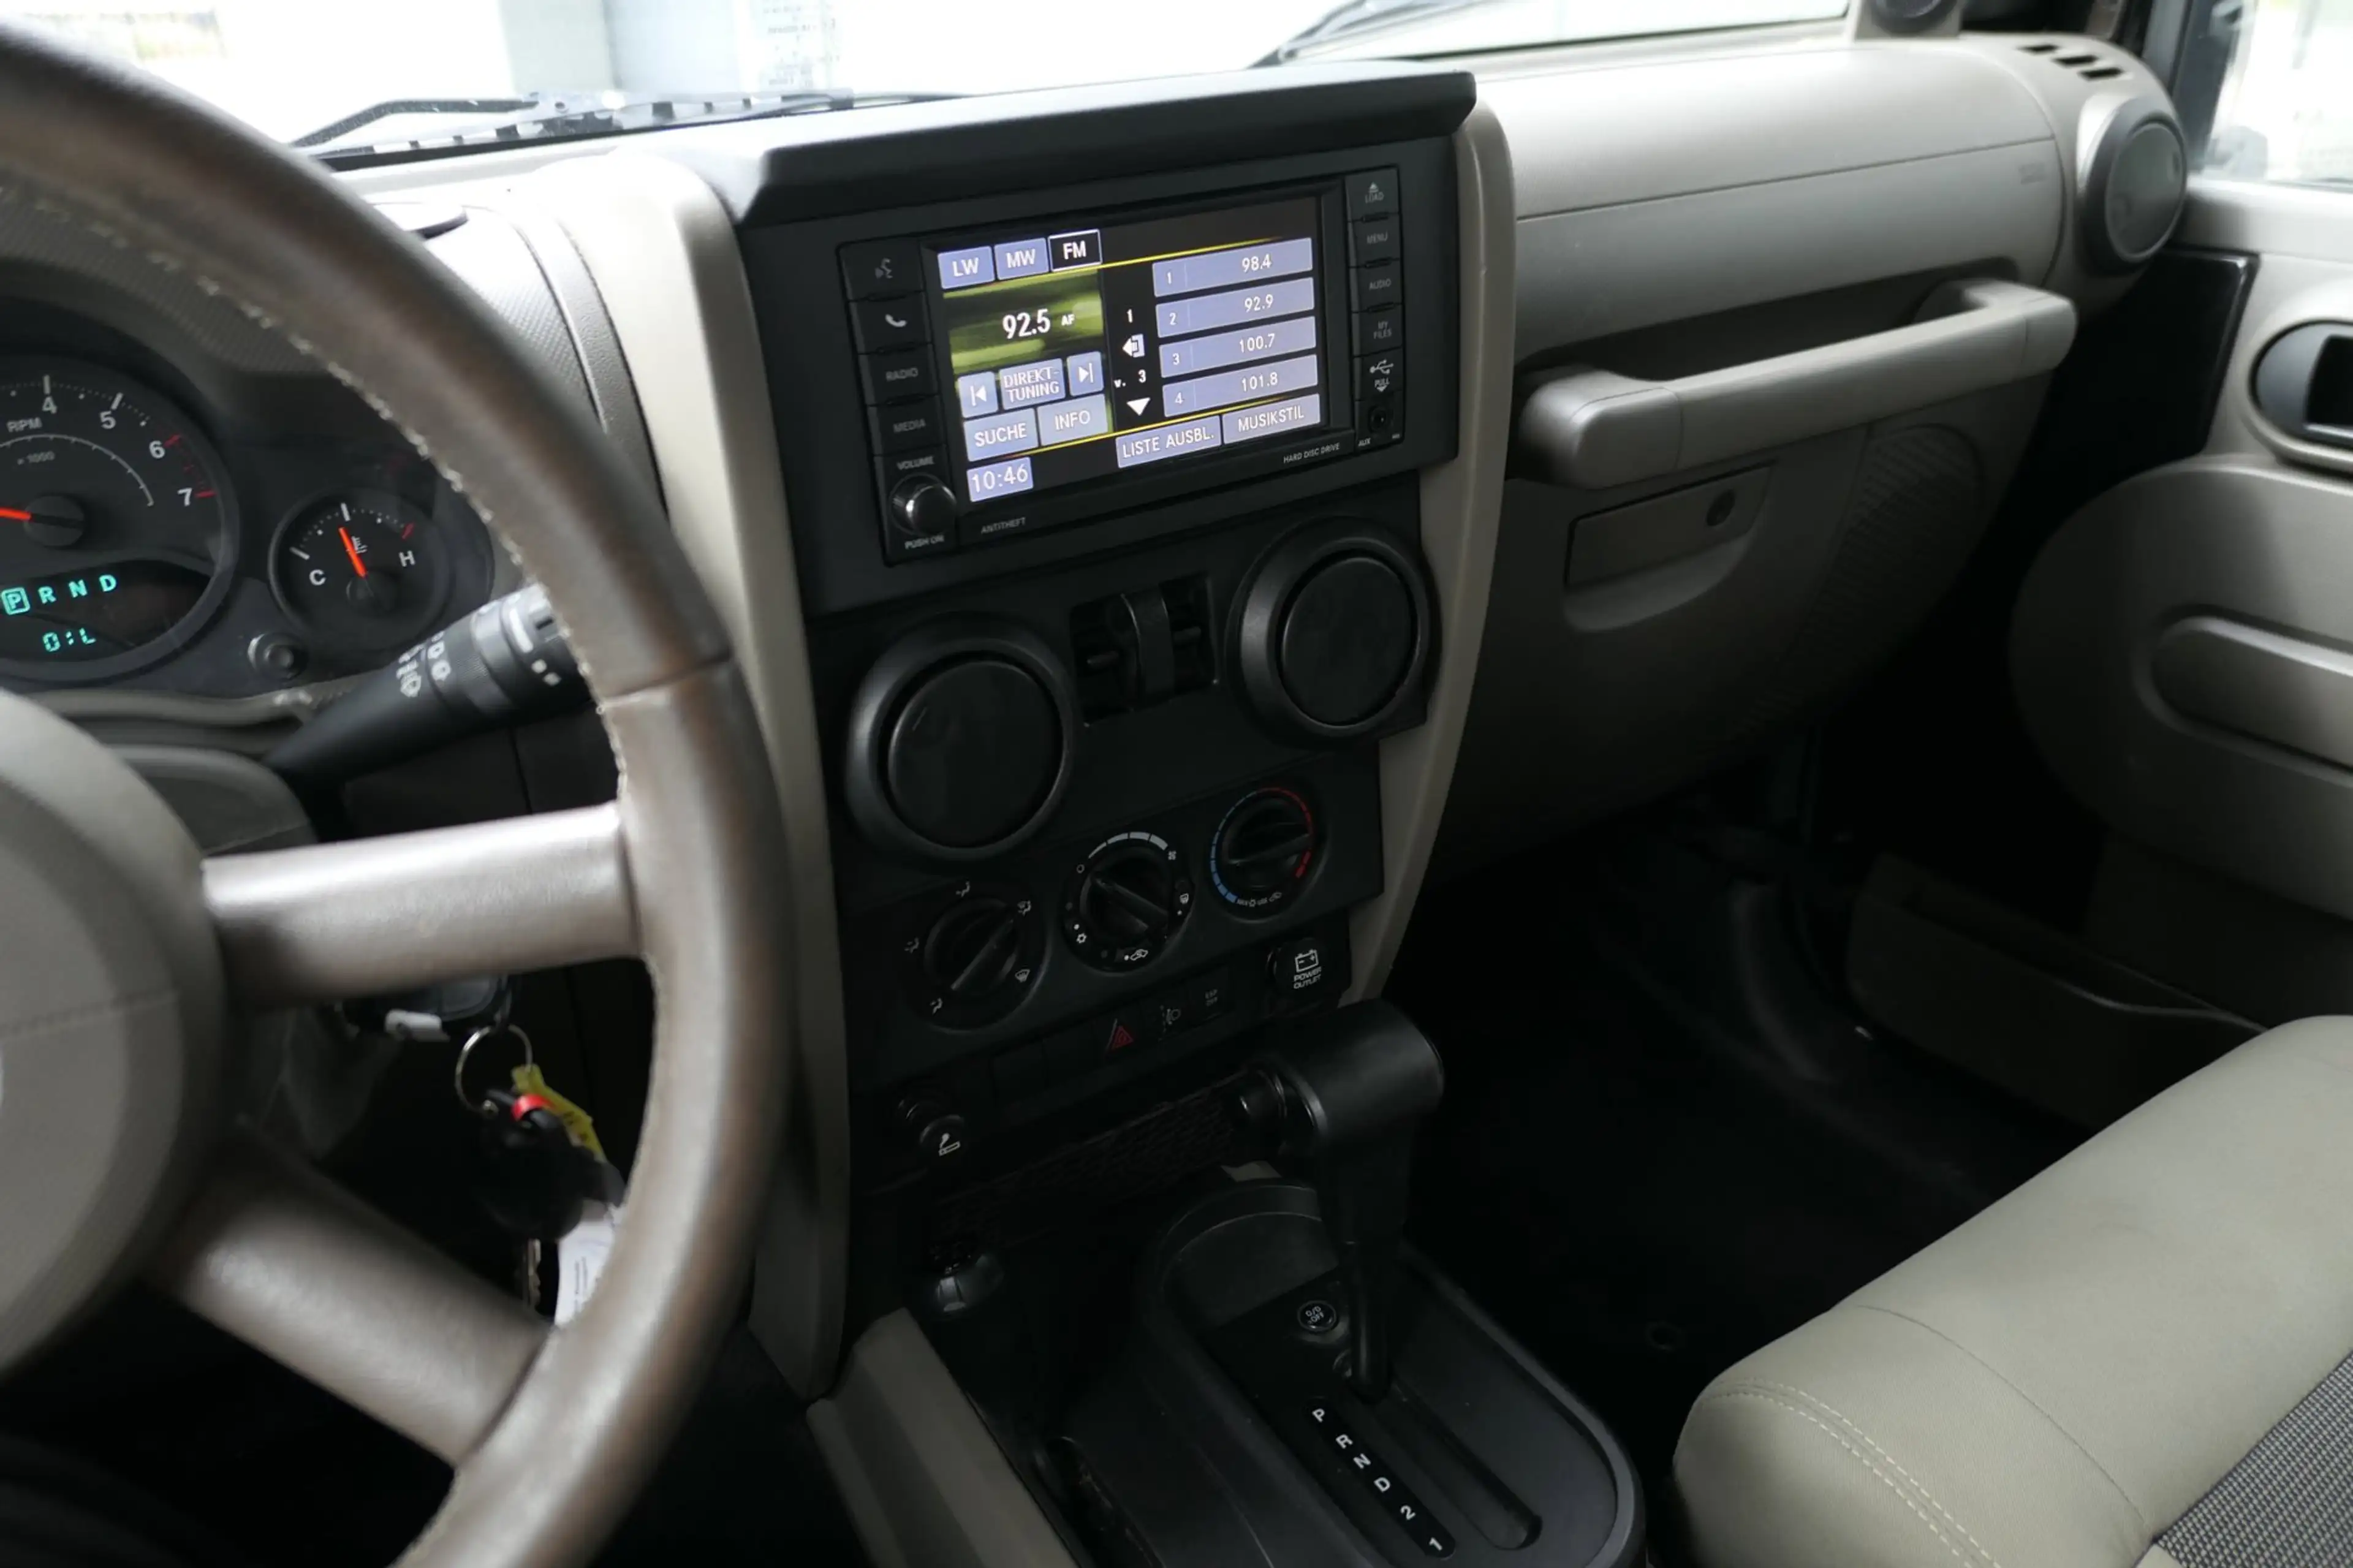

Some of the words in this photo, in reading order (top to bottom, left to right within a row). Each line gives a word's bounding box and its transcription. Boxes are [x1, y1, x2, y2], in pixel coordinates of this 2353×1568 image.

[1367, 232, 1389, 244] MENU
[1007, 248, 1036, 268] MW
[1063, 240, 1087, 260] FM
[952, 257, 979, 277] LW
[1167, 272, 1173, 285] 1
[1241, 253, 1272, 273] 98.4
[1369, 278, 1392, 290] AUDIO
[1126, 309, 1133, 324] 1
[1169, 312, 1178, 326] 2
[1244, 294, 1274, 312] 92.9
[1002, 308, 1051, 339] 92.5
[1061, 313, 1075, 327] AF
[1377, 320, 1389, 330] MY
[1373, 328, 1392, 339] FILES
[1172, 352, 1180, 366] 3
[1239, 333, 1275, 354] 100.7
[885, 367, 919, 381] RADIO
[1004, 366, 1060, 388] DIREKT-
[1138, 369, 1146, 384] 3
[1006, 381, 1059, 403] TUNING
[1175, 392, 1184, 404] 4
[1241, 373, 1278, 392] 101.8
[42, 395, 58, 414] 4
[6, 417, 42, 433] RPM
[99, 411, 116, 430] 5
[893, 418, 926, 433] MEDIA
[1054, 410, 1091, 431] INFO
[1237, 404, 1305, 433] MUSIKSTIL
[974, 422, 1028, 447] SUCHE
[1122, 436, 1161, 458] LISTE
[1165, 426, 1214, 449] AUSBL.
[148, 440, 165, 460] 6
[1283, 452, 1302, 464] HARD
[1303, 448, 1319, 459] DISC
[1320, 442, 1341, 455] DRIVE
[896, 456, 934, 470] VOLUME
[971, 464, 1028, 493] 10:46
[177, 488, 193, 507] 7
[980, 517, 1026, 534] ANTITHEFT
[904, 537, 930, 550] PUSH
[930, 534, 944, 545] ON
[398, 550, 416, 567] H
[309, 569, 327, 586] C
[7, 593, 22, 610] P
[37, 586, 58, 604] R
[68, 578, 88, 598] N
[99, 574, 118, 593] D
[1294, 966, 1322, 982] POWER
[1294, 974, 1322, 989] OUTLET
[1311, 1408, 1325, 1423] P
[1335, 1434, 1354, 1449] R
[1352, 1453, 1371, 1469] N
[1373, 1476, 1391, 1493] D
[1400, 1505, 1416, 1520] 2
[1428, 1537, 1443, 1552] 1
